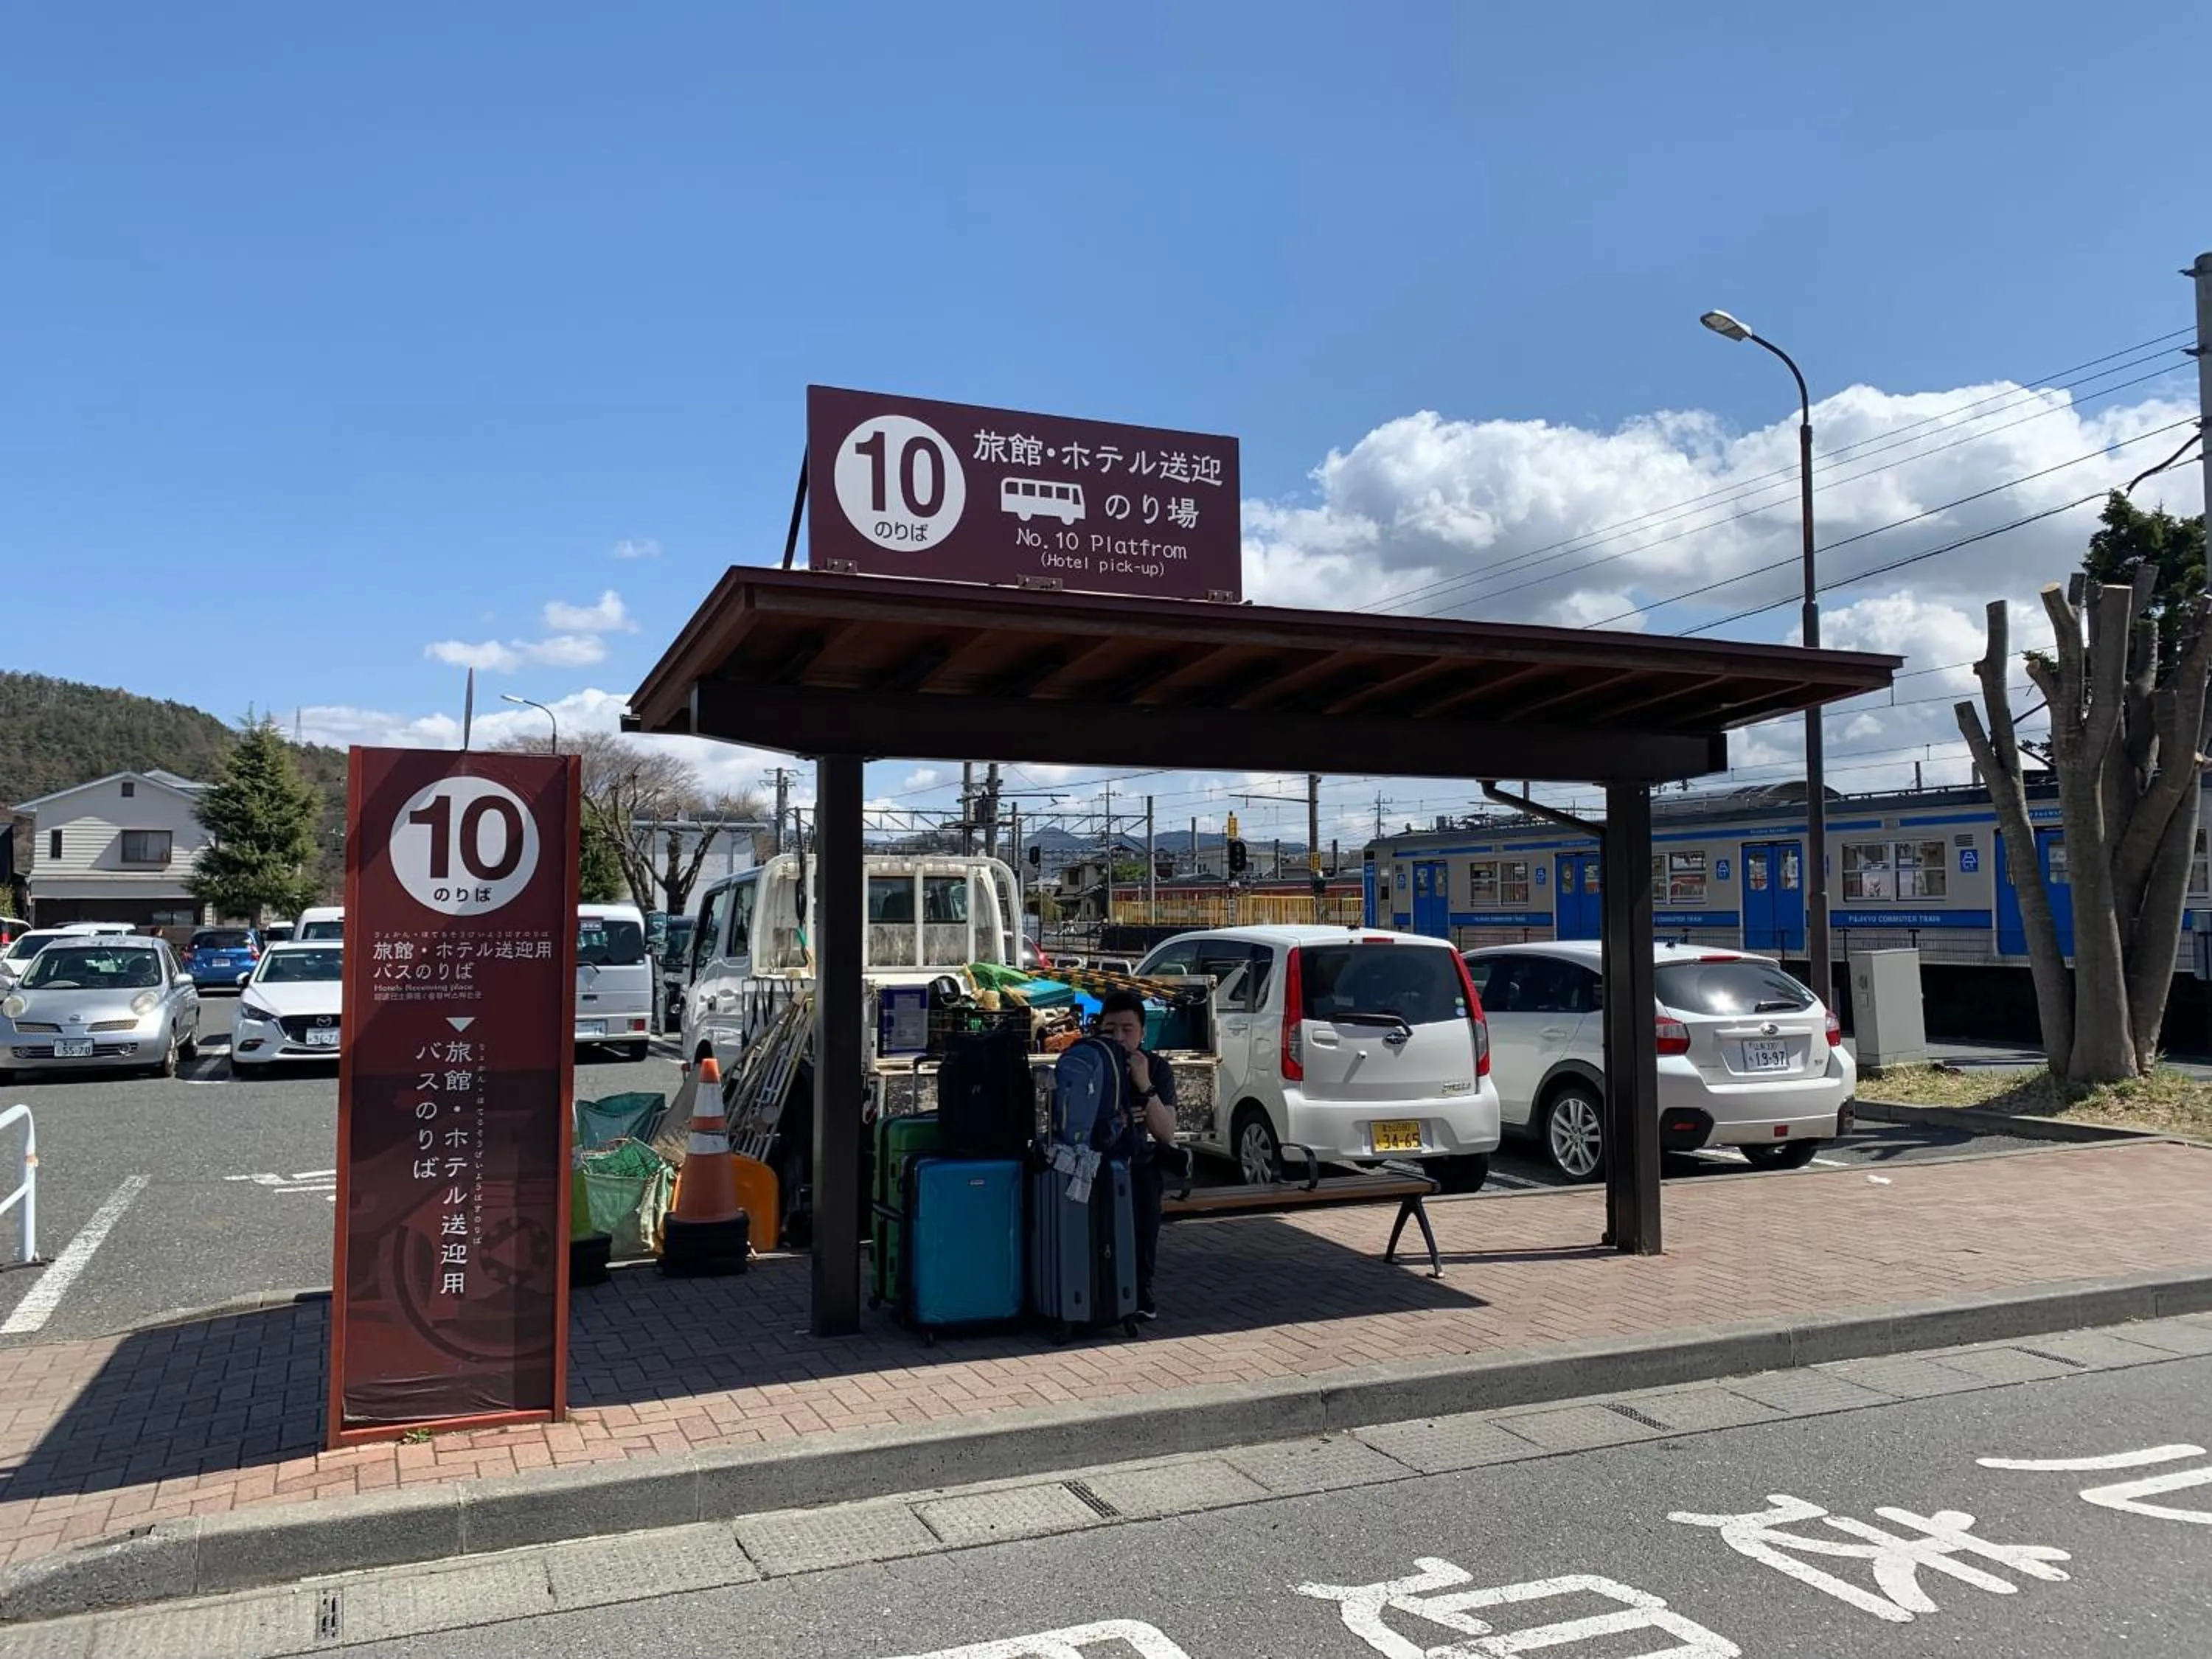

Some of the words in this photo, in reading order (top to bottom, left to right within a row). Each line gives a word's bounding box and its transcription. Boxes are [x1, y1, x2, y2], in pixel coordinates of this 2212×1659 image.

[973, 428, 1223, 487] 旅館・ホテル送迎
[855, 431, 946, 518] 10
[1105, 493, 1200, 529] のり場
[874, 520, 929, 543] のりば
[1090, 534, 1188, 560] Platfrom
[1040, 554, 1089, 571] (Hotel
[1099, 559, 1165, 578] pick-up)
[409, 795, 524, 881] 10
[434, 886, 492, 902] のりば
[372, 941, 552, 960] 旅館・ホテル送迎用
[374, 961, 475, 981] バスのりば
[413, 1040, 442, 1180] バスのりば
[439, 1040, 473, 1295] 旅館・ホテル送迎用
